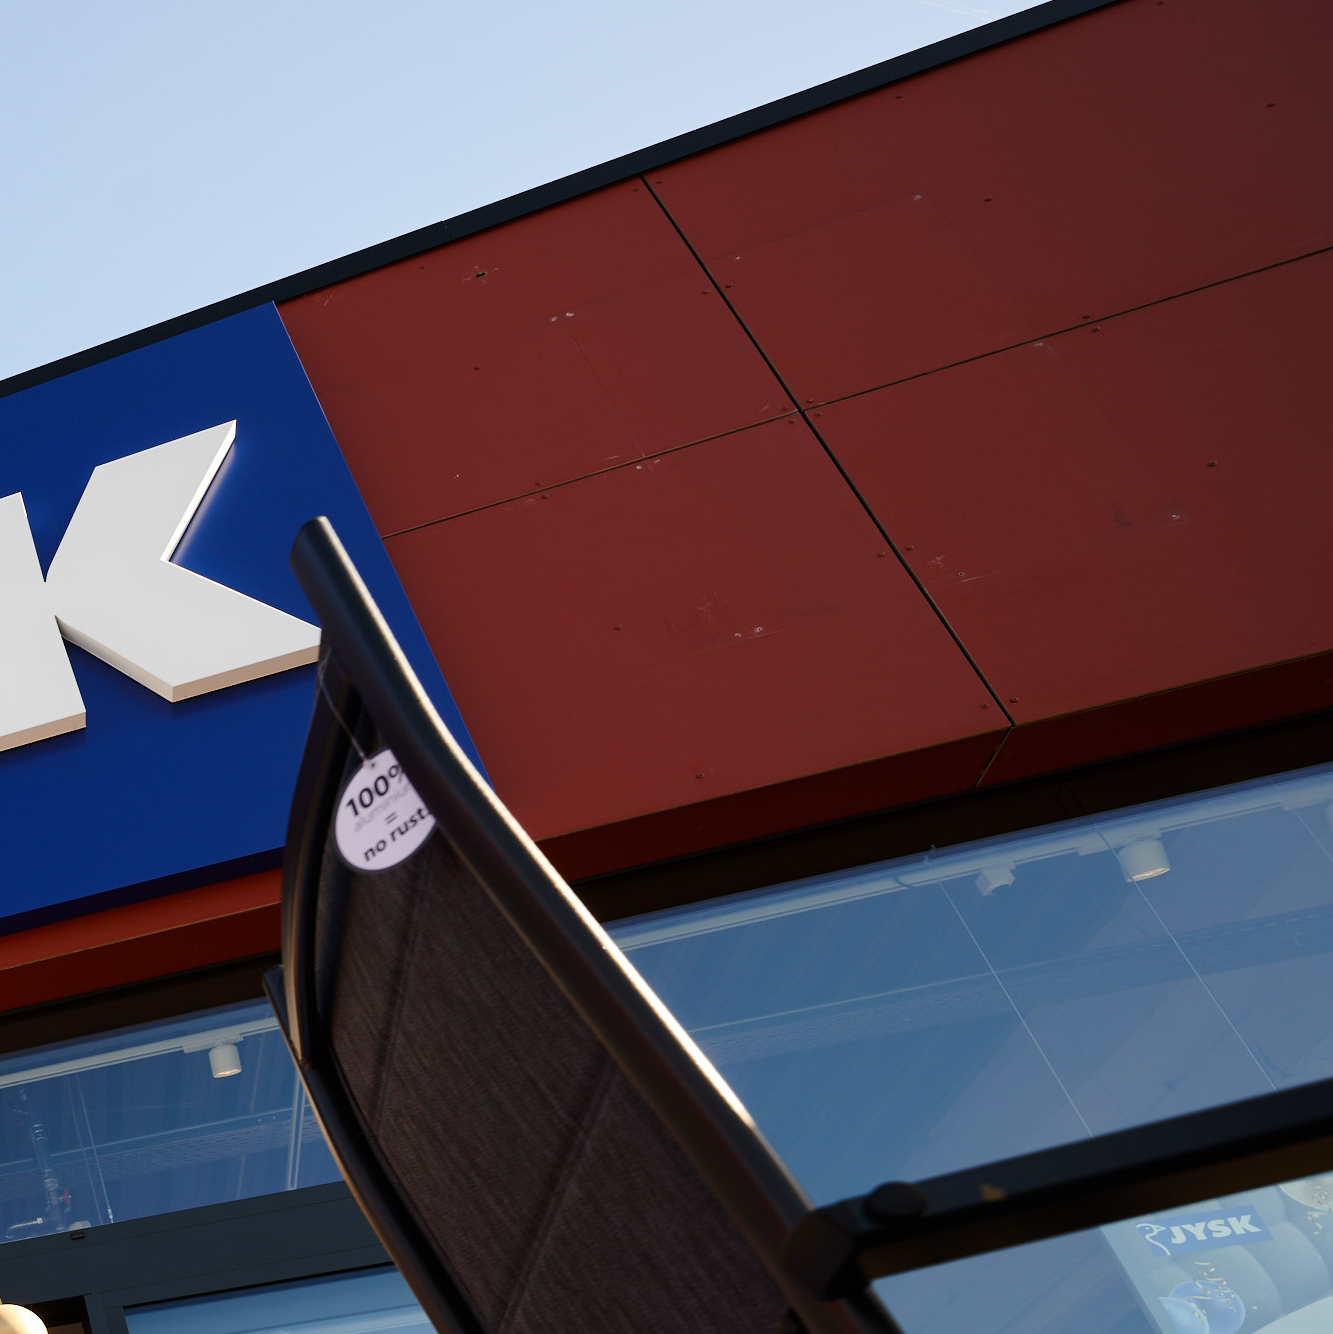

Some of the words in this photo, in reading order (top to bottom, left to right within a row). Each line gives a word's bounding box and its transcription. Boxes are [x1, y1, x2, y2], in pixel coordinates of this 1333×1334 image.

[363, 839, 388, 862] no
[389, 808, 426, 841] rust
[1169, 1213, 1263, 1245] JYSK
